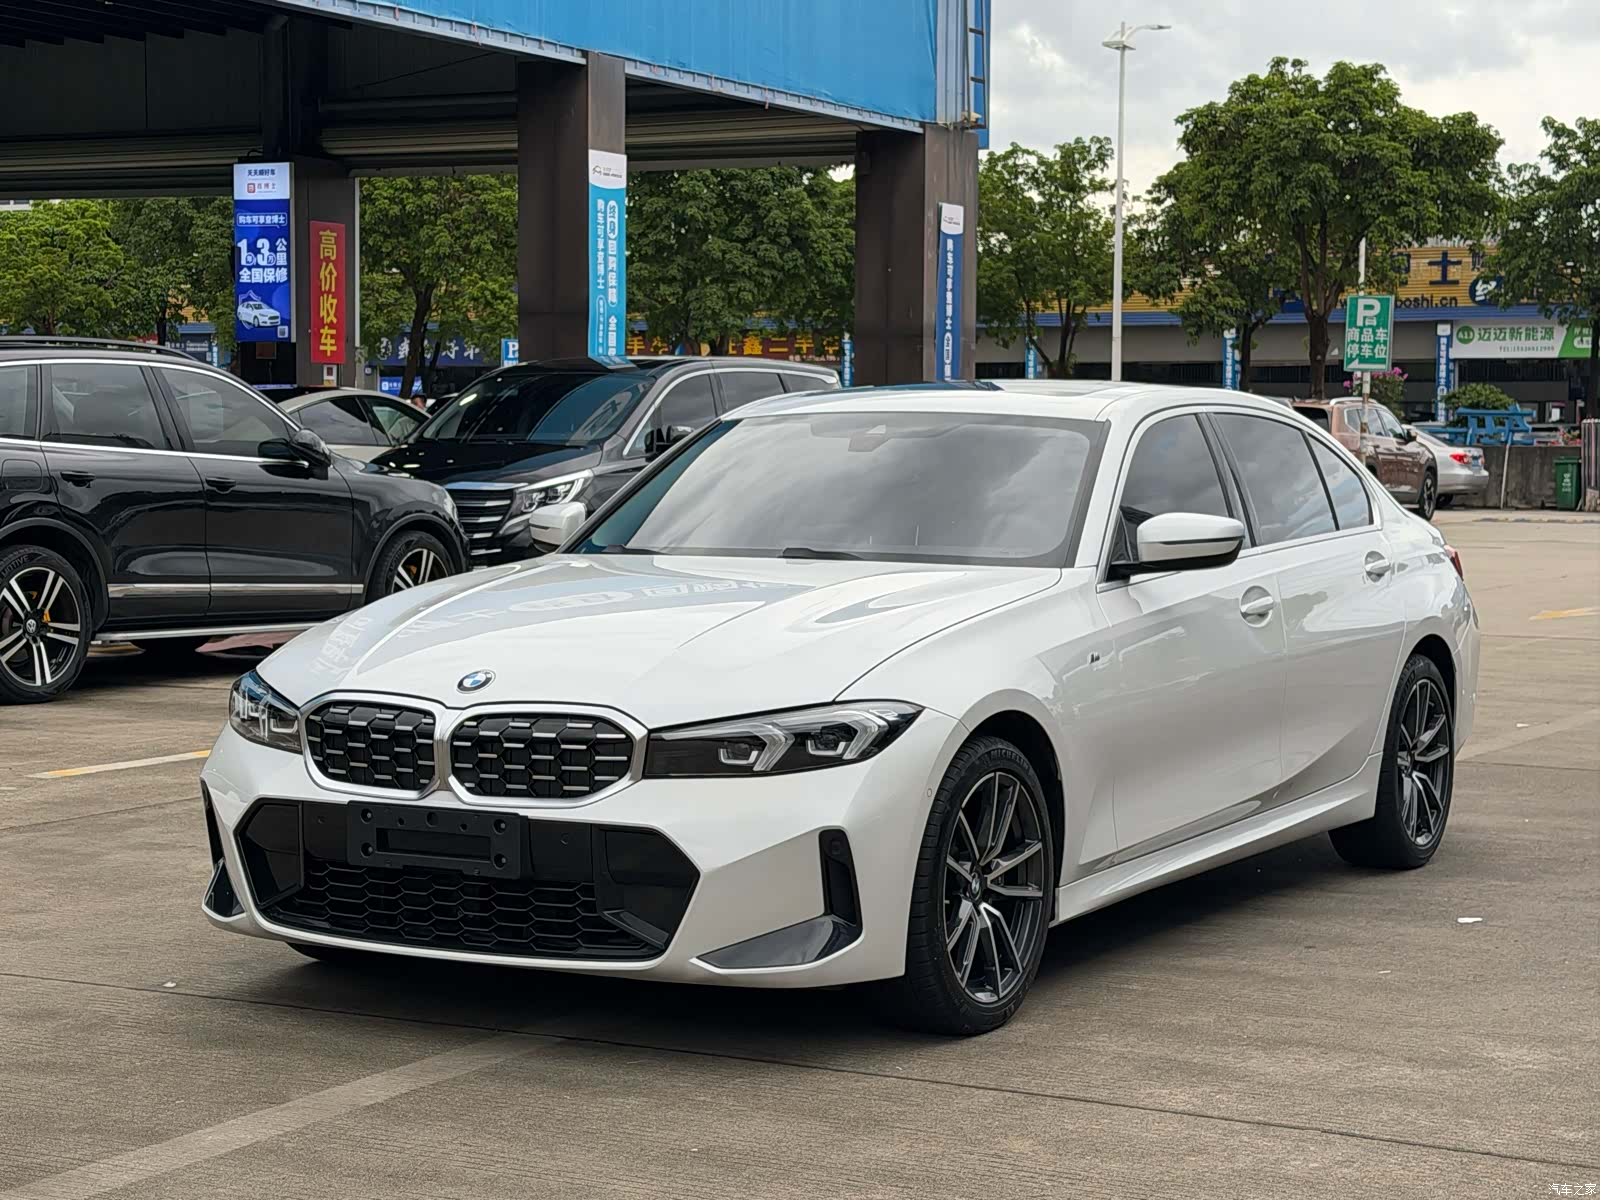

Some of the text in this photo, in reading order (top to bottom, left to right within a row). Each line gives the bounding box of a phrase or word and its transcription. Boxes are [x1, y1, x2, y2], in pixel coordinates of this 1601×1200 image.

[238, 214, 286, 225] 购车可享查博士
[239, 267, 288, 284] 全国保修
[319, 230, 338, 357] 高价收车
[1356, 298, 1381, 326] P
[1347, 327, 1388, 343] 商品车
[1477, 326, 1555, 342] 迈迈新能源
[1347, 343, 1387, 358] 停车位
